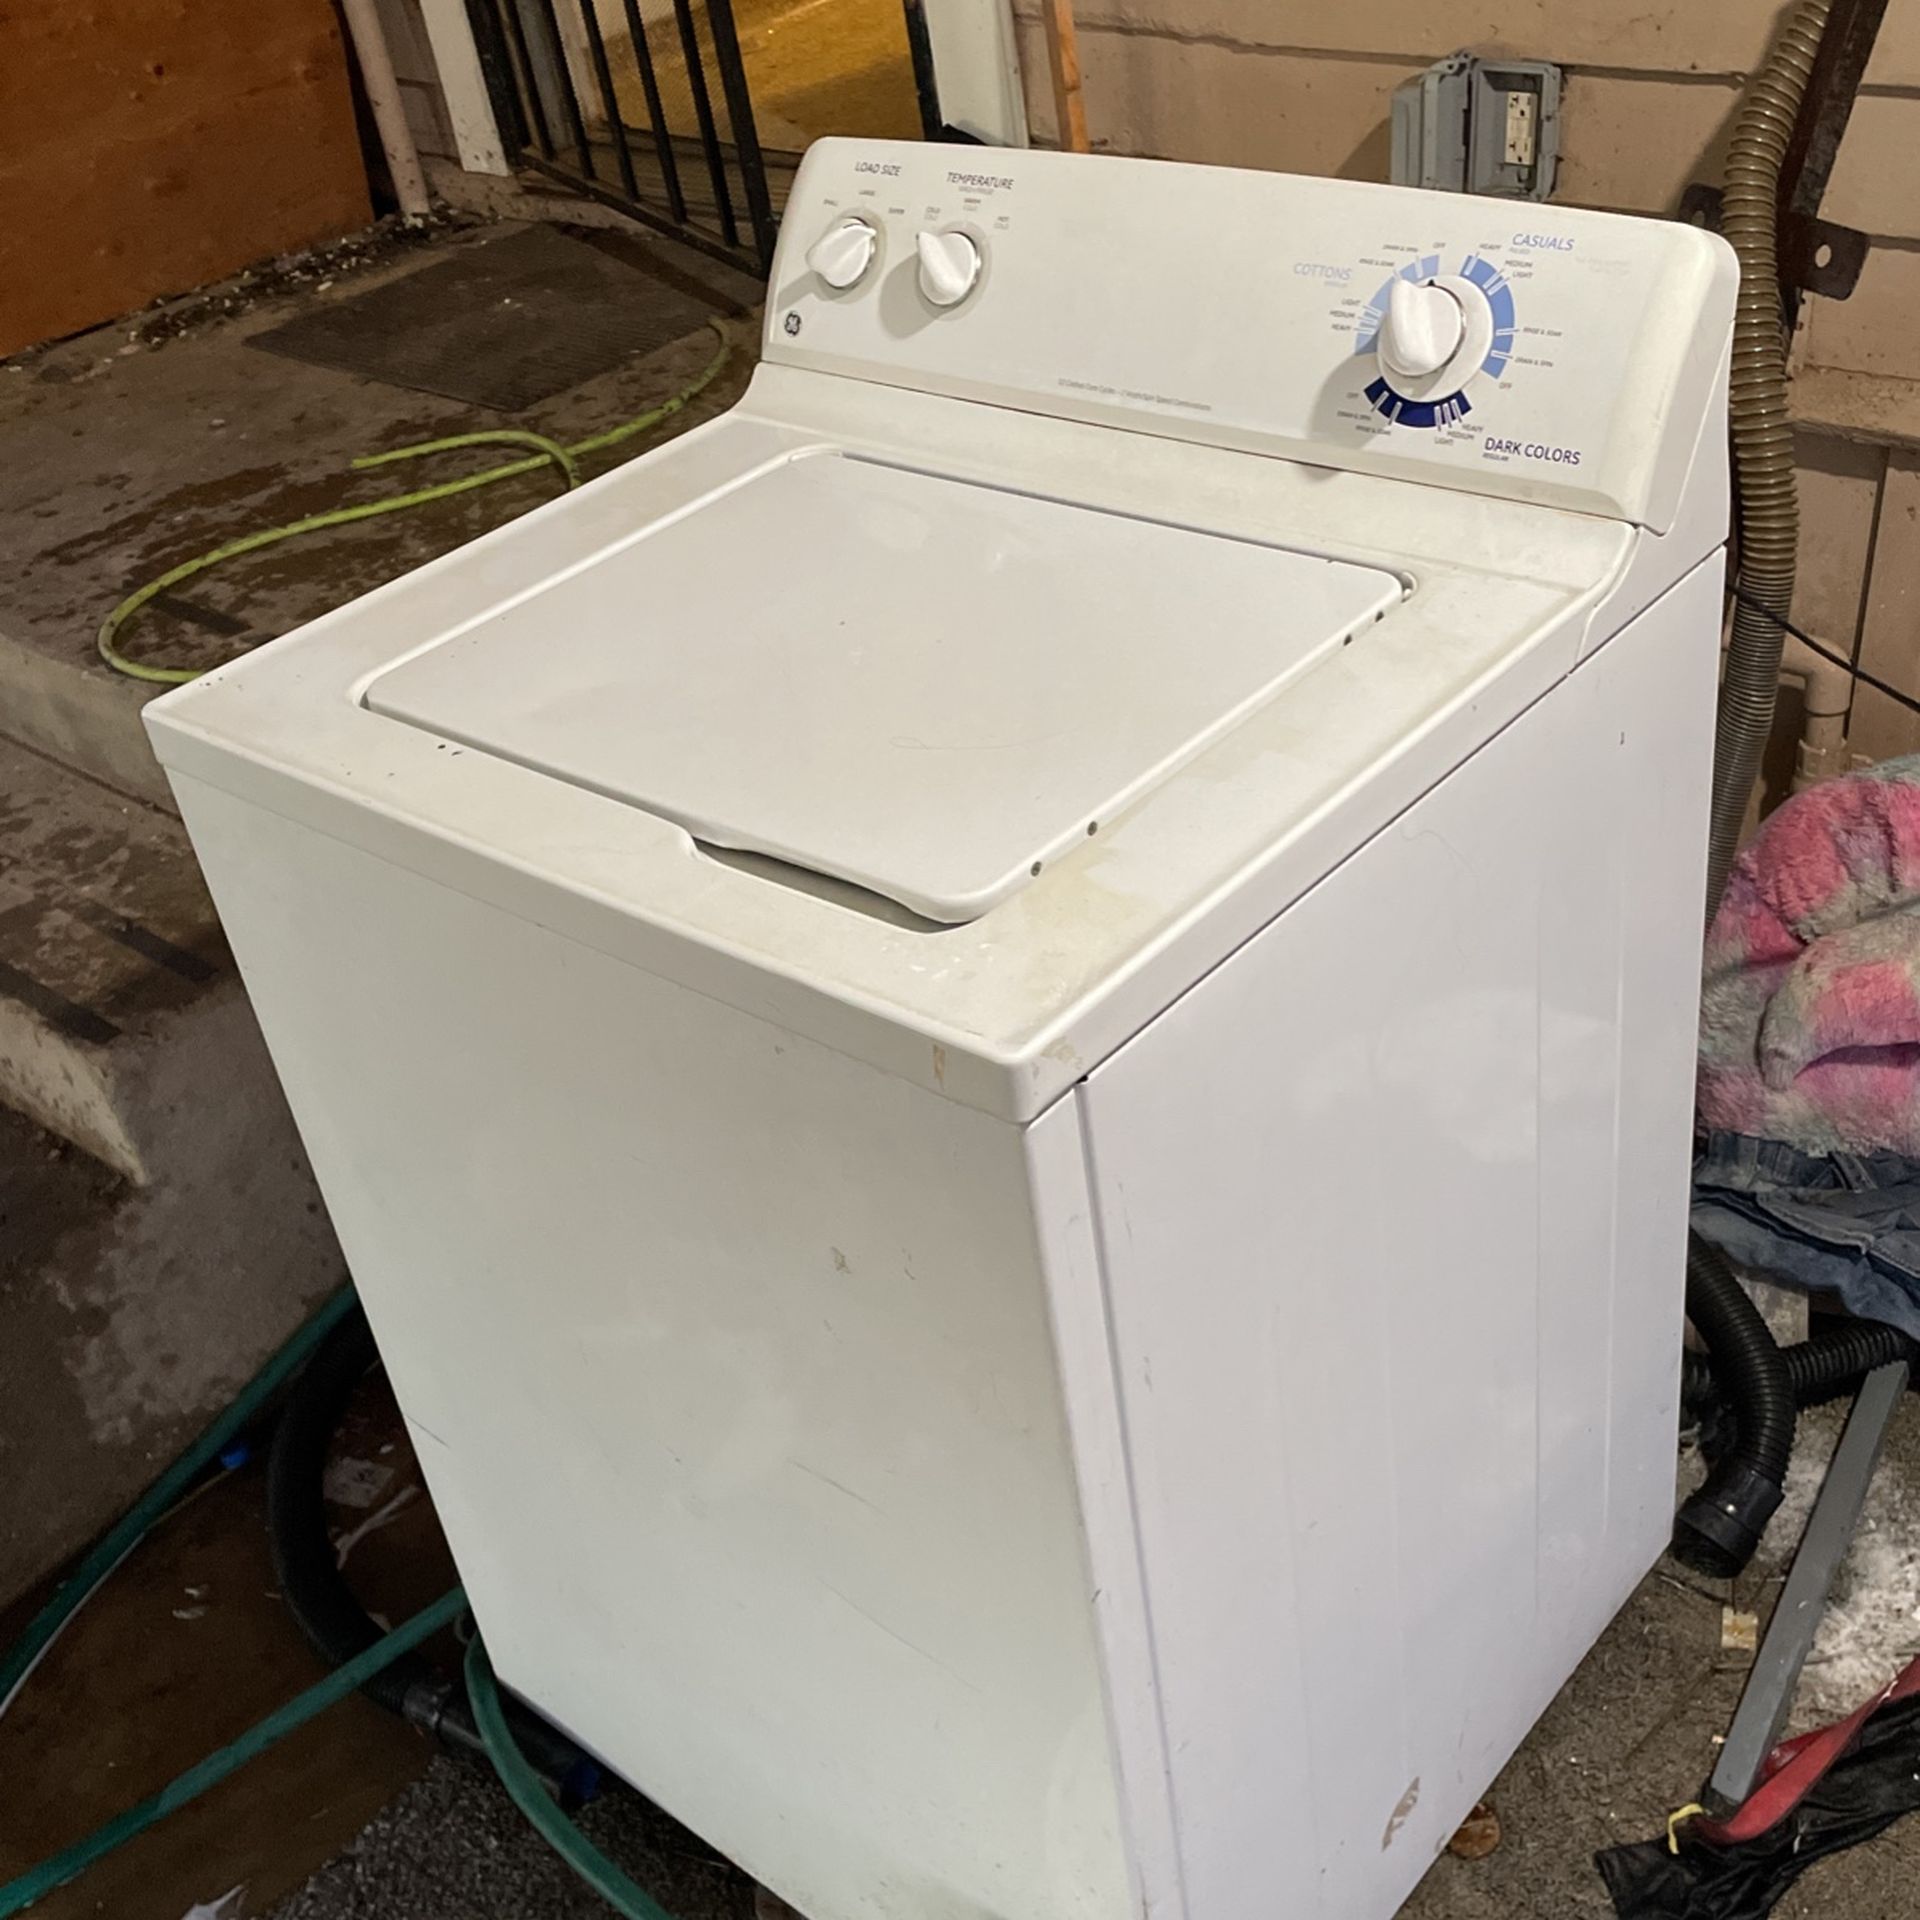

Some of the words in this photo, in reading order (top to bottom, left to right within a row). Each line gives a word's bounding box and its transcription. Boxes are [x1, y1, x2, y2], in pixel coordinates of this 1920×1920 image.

[854, 161, 880, 175] LOAD
[880, 164, 902, 177] SIZE
[946, 171, 1014, 190] TEMPERATURE
[1511, 233, 1575, 252] CASUALS
[1293, 262, 1352, 281] COTTONS
[1484, 437, 1521, 456] DARK
[1524, 444, 1582, 466] COLORS
